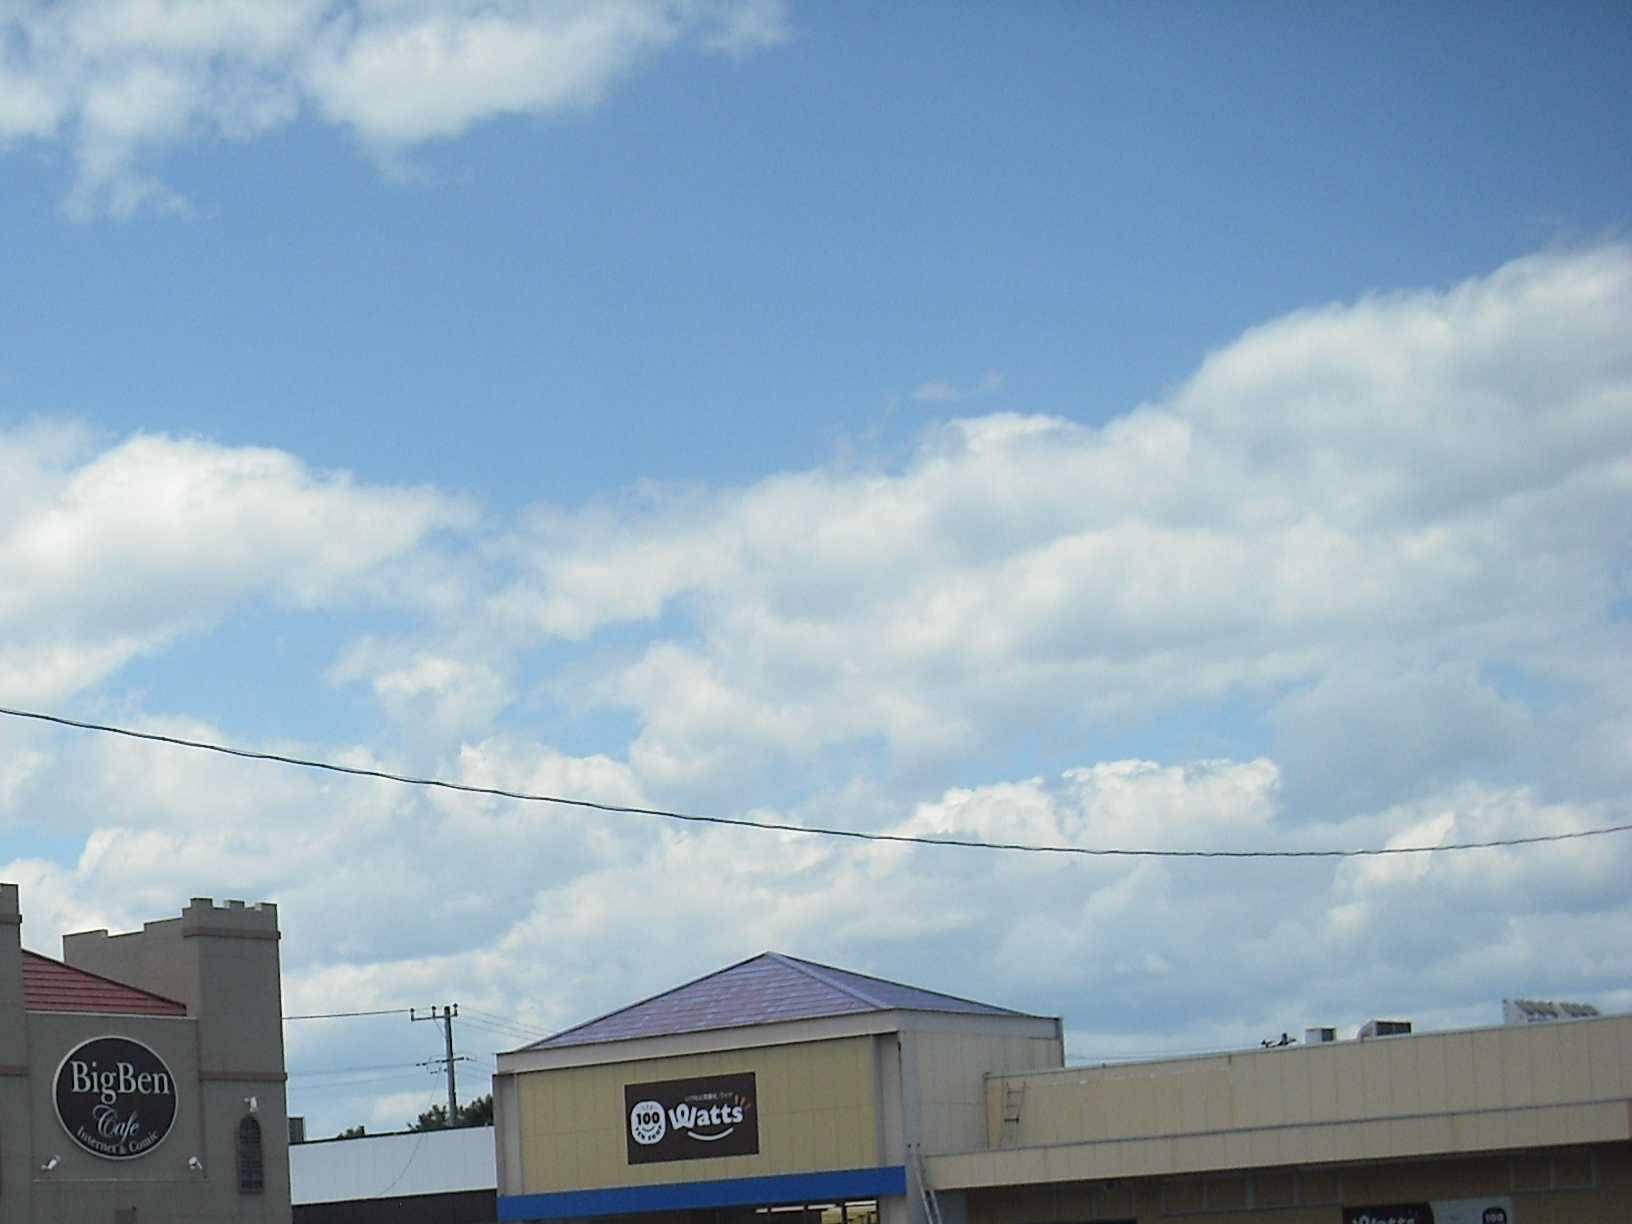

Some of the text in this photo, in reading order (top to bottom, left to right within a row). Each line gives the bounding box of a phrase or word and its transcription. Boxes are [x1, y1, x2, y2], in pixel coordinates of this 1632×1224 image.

[70, 1061, 170, 1104] BigBen
[92, 1105, 139, 1145] Cafe
[636, 1112, 660, 1125] 100
[668, 1103, 744, 1130] Watts
[77, 1126, 117, 1154] Internet
[128, 1130, 159, 1152] Comic
